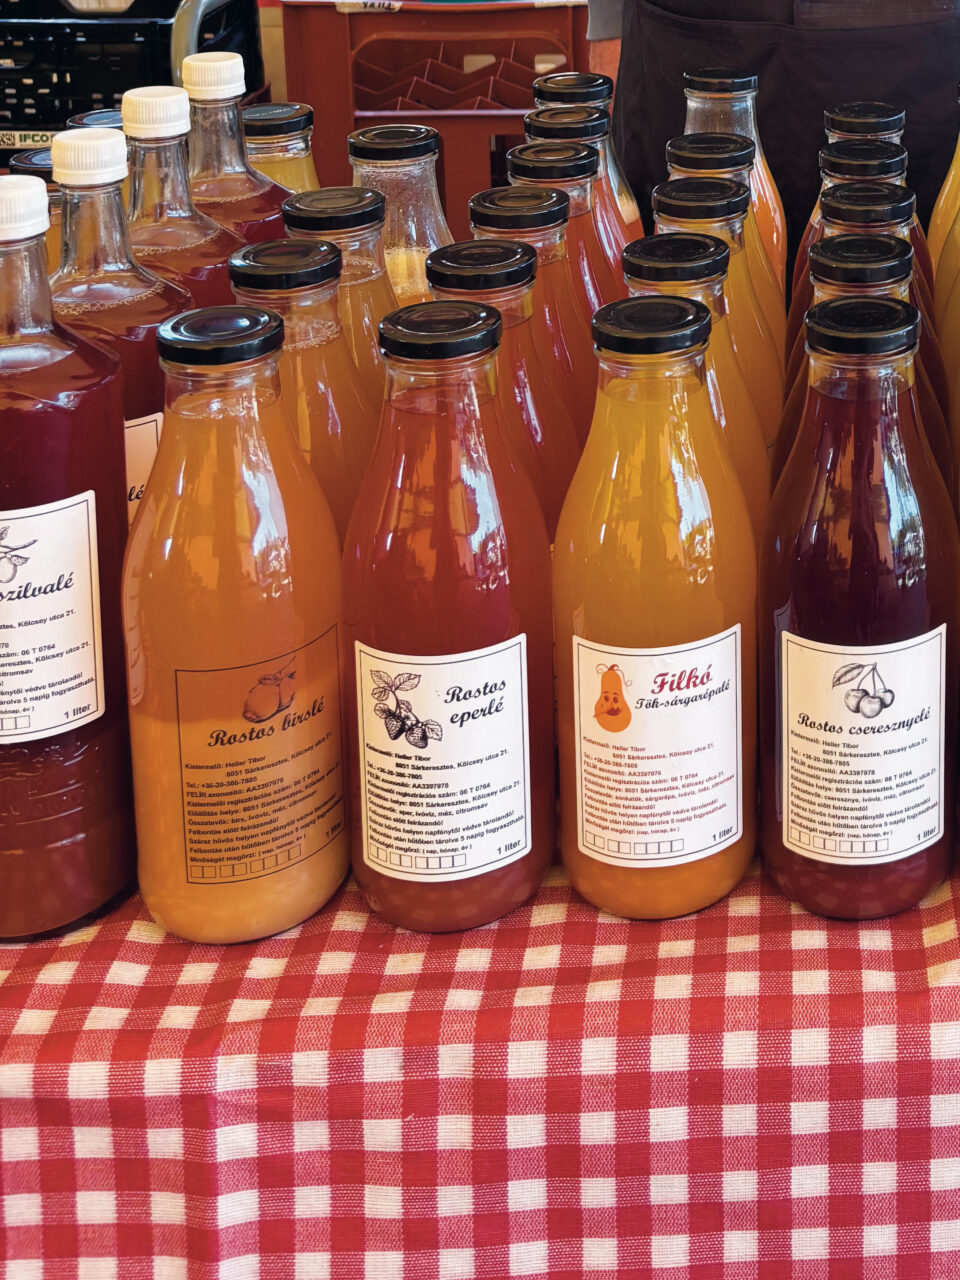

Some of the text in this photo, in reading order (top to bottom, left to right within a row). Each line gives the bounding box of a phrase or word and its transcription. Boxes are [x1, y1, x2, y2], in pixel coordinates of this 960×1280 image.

[18, 617, 48, 628] Kölcsey
[49, 613, 65, 621] utca
[35, 652, 65, 663] Kölcsey
[25, 684, 47, 693] védve
[48, 671, 83, 688] tárolandó!
[651, 664, 713, 695] Filkó
[29, 692, 50, 702] napig
[444, 679, 507, 704] Rostos
[635, 679, 731, 710] Tök-sárgarépalé
[73, 703, 91, 716] liter
[450, 696, 504, 728] eperlé
[208, 695, 325, 747] Rostos birslé
[797, 705, 932, 737] Rostos cseresznyelé
[457, 758, 484, 768] Kölcsey
[485, 753, 499, 761] utca
[472, 790, 498, 802] Kölcsey
[462, 823, 482, 832] védve
[482, 810, 515, 826] tárolandó!
[466, 831, 485, 840] napig
[718, 826, 733, 840] liter
[923, 826, 937, 838] liter
[497, 839, 521, 855] 1 liter
